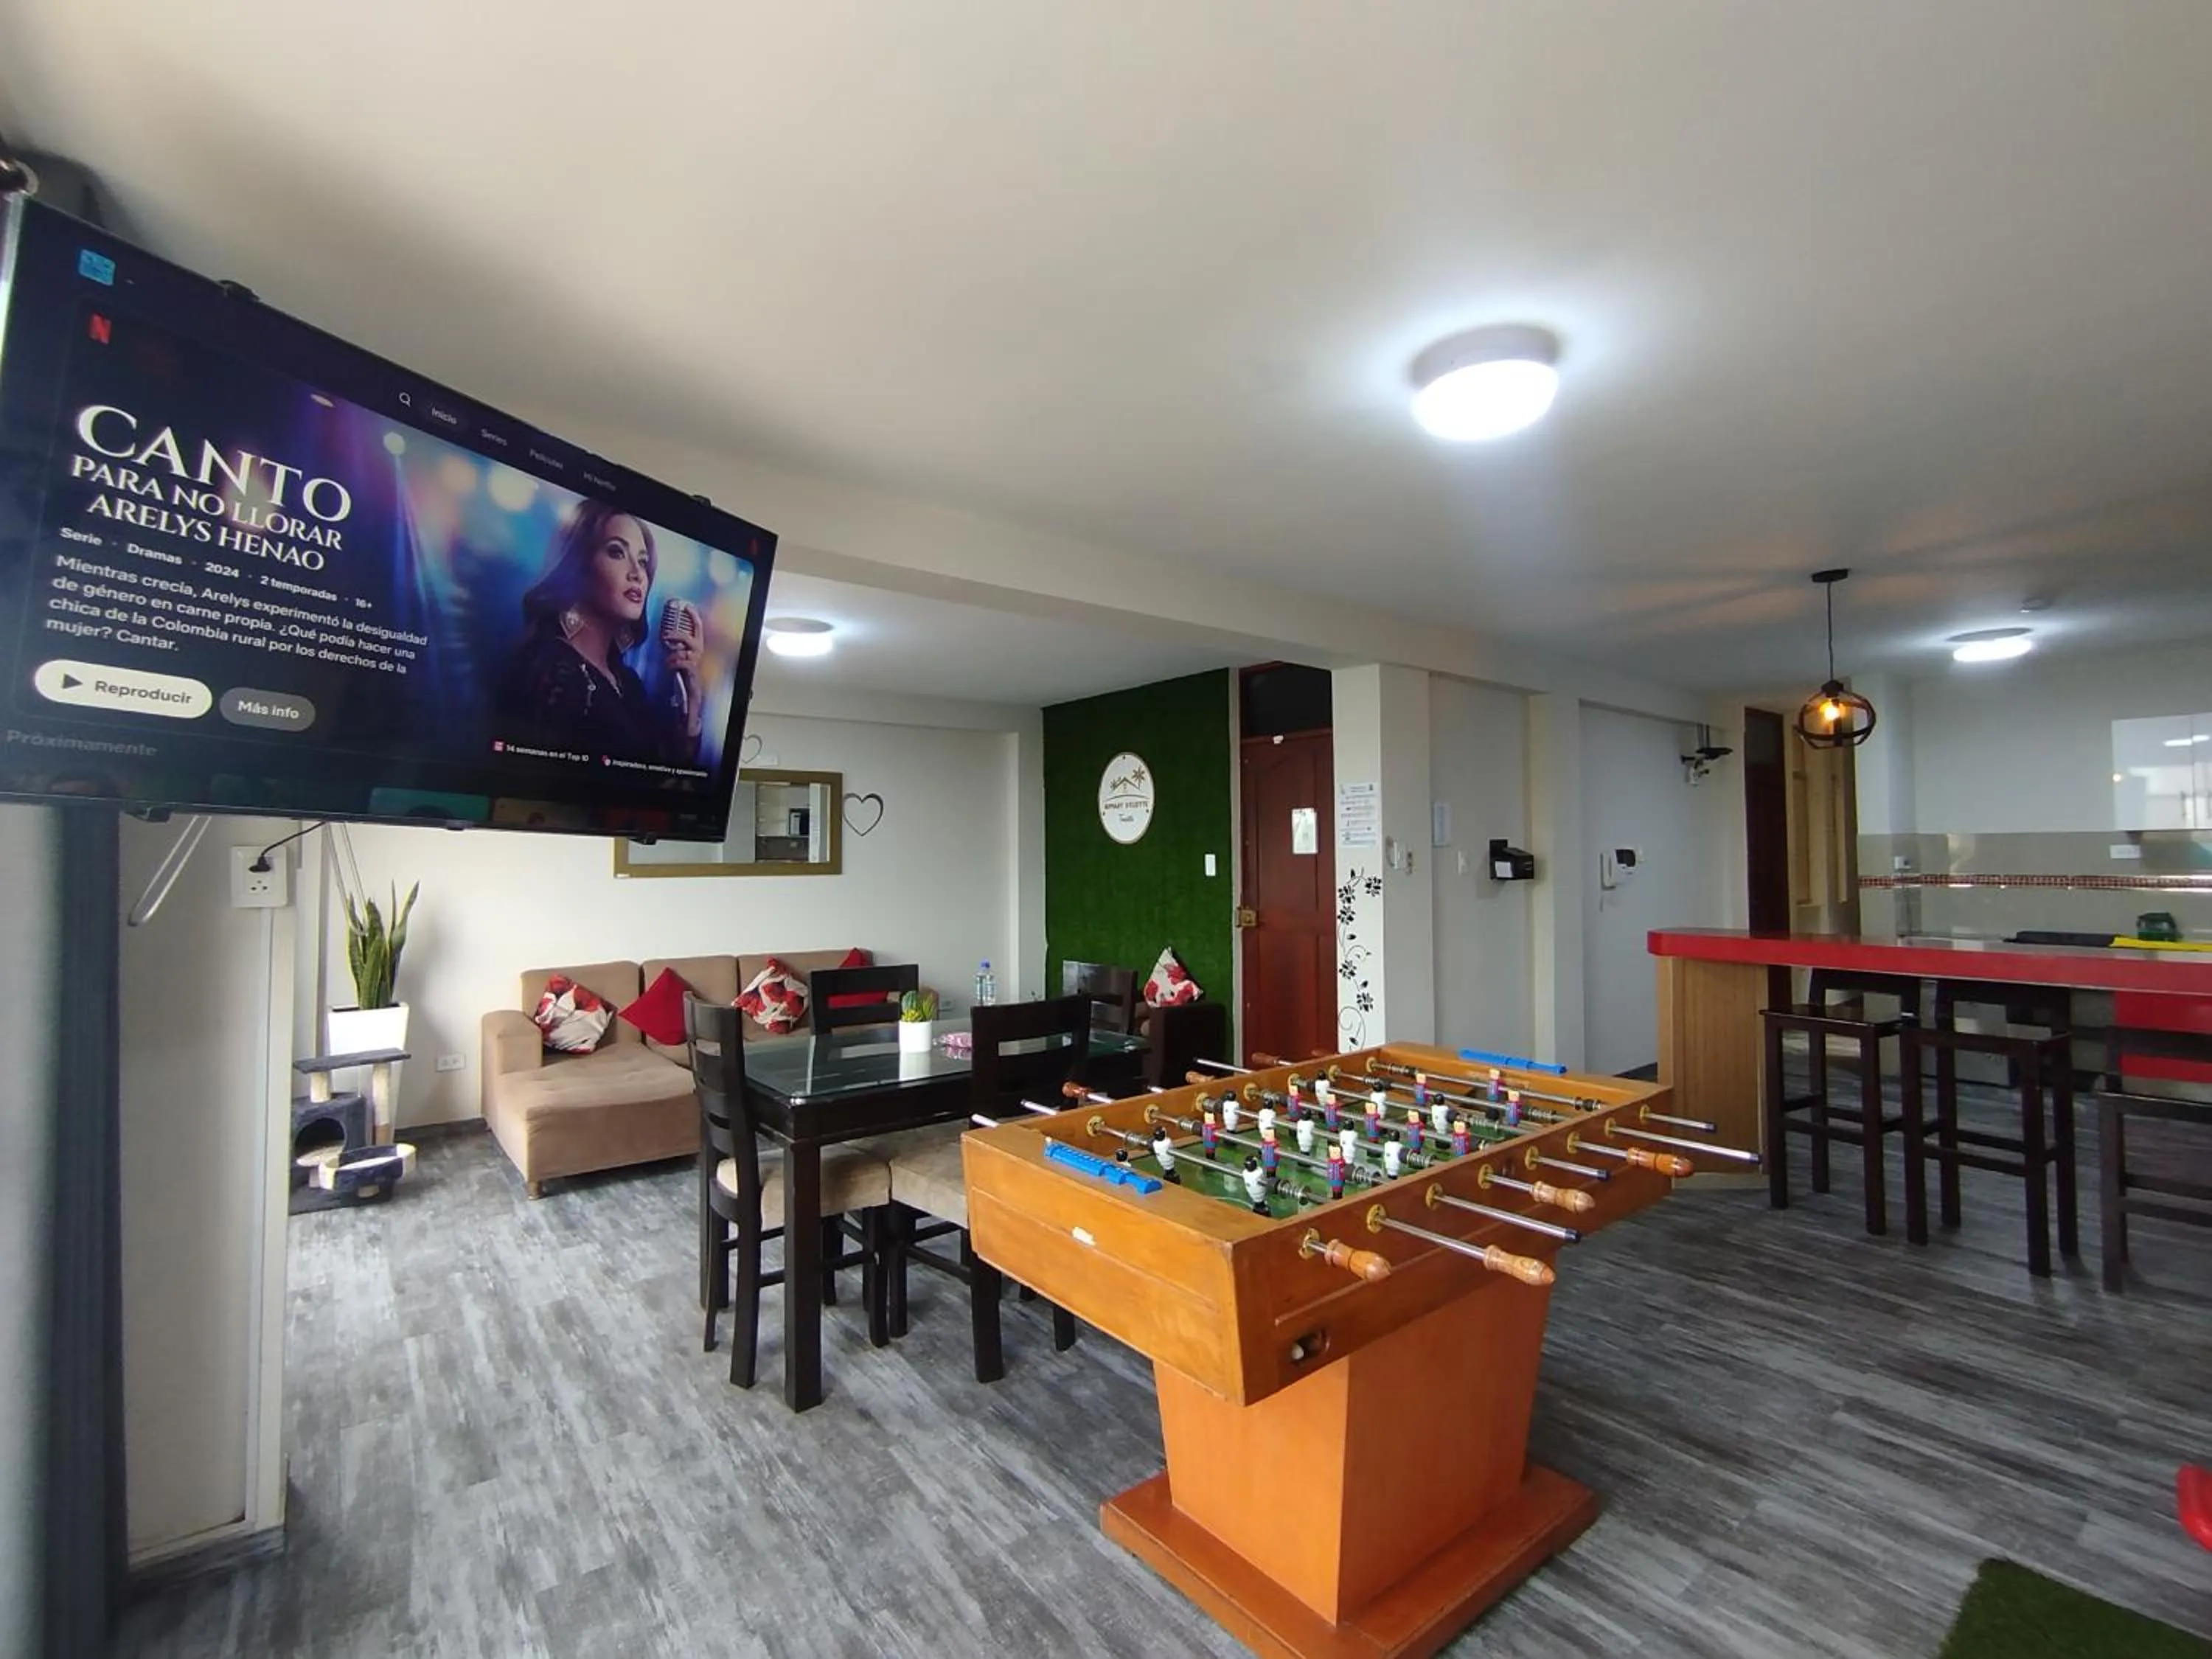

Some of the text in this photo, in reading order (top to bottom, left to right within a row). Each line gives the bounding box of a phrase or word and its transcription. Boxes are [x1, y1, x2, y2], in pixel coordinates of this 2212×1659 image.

[77, 404, 352, 523] CANTO
[481, 428, 508, 446] Series
[71, 453, 344, 551] PARA NO LLORAR
[87, 493, 325, 571] ARELYS HENAO
[56, 554, 138, 583] Mientras
[201, 588, 251, 609] Arelys
[253, 600, 340, 628] experimentó
[342, 618, 353, 631] la
[355, 622, 428, 646] desigualdad
[60, 526, 103, 546] Serie
[126, 543, 183, 565] Dramas
[204, 561, 240, 579] 2024
[260, 575, 269, 586] 2
[271, 578, 338, 602] temporadas
[46, 618, 180, 652] mujer? Cantar.
[49, 597, 407, 675] chica de la Colombia rural por los derechos de la
[52, 576, 79, 591] de
[83, 584, 147, 606] género
[150, 597, 173, 611] en
[176, 603, 222, 621] carne
[223, 611, 276, 632] propia.
[279, 624, 317, 640] ¿Qué
[358, 638, 392, 655] hacer
[394, 648, 416, 660] una
[94, 680, 193, 706] Reproducir
[237, 698, 299, 720] Más info
[5, 729, 159, 757] Próximamente
